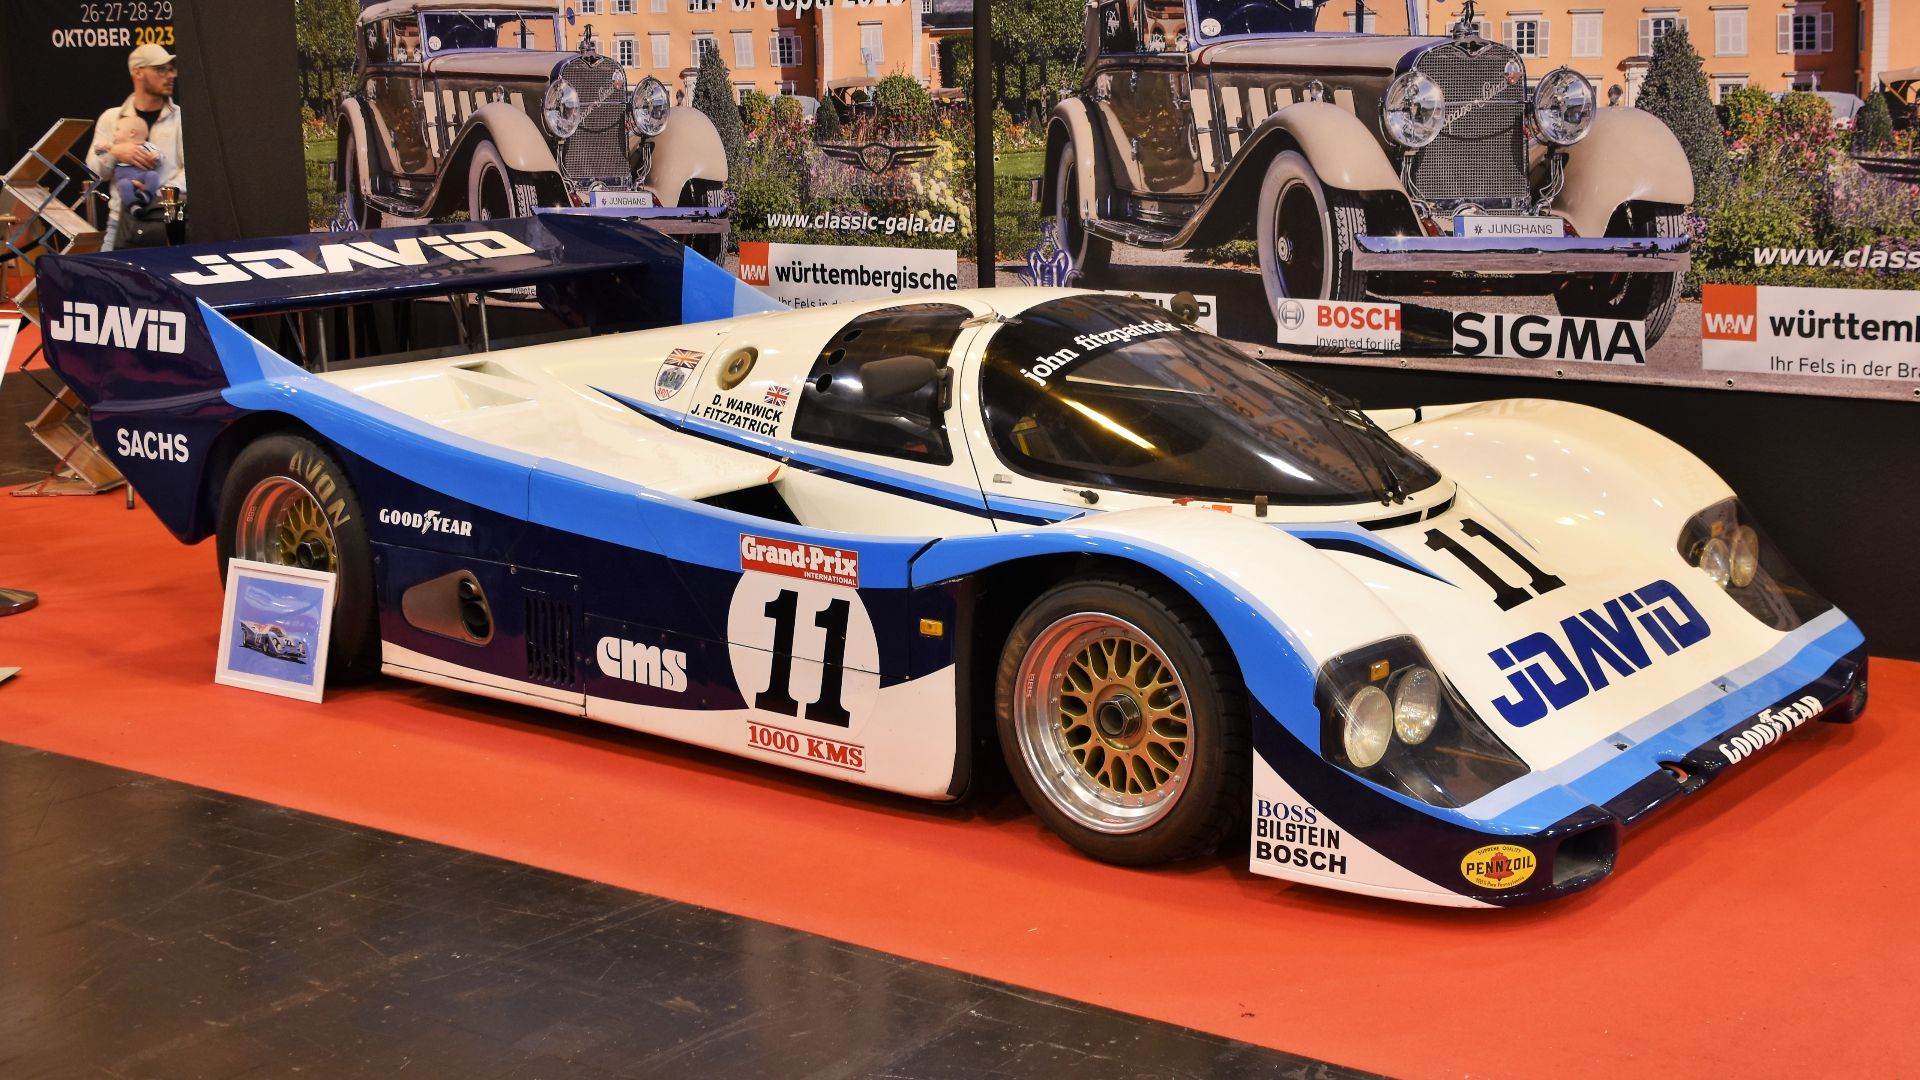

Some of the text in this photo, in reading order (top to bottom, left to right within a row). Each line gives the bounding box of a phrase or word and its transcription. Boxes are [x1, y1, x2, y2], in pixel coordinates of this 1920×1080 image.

[80, 1, 173, 22] 26-27-28-29
[52, 26, 175, 48] OKTOBER 2023
[609, 196, 647, 206] JUNGHANS
[767, 211, 956, 235] www.classic-gala.de
[1488, 223, 1553, 235] JUNGHANS
[775, 260, 957, 293] württembergische
[1317, 304, 1401, 331] BOSCH
[1316, 336, 1401, 351] Invented for life
[1453, 312, 1646, 364] SIGMA
[1020, 319, 1182, 387] john fitzpatrick
[1770, 356, 1793, 372] Ihr
[1799, 357, 1835, 374] Fels
[1841, 359, 1856, 375] in
[1863, 360, 1892, 377] der
[691, 403, 779, 437] J. FITZPATRICK
[712, 394, 783, 423] D. WARWICK
[116, 428, 189, 463] SACHS
[289, 450, 351, 528] AVON
[804, 571, 857, 586] INTERNATIONAL
[1423, 518, 1567, 612] 11
[755, 588, 850, 728] 11
[748, 725, 863, 768] 1000 KMS
[1257, 799, 1317, 824] BOSS
[1256, 818, 1340, 849] BILSTEIN
[1256, 840, 1347, 875] BOSCH
[1466, 855, 1534, 876] PENNZOIL
